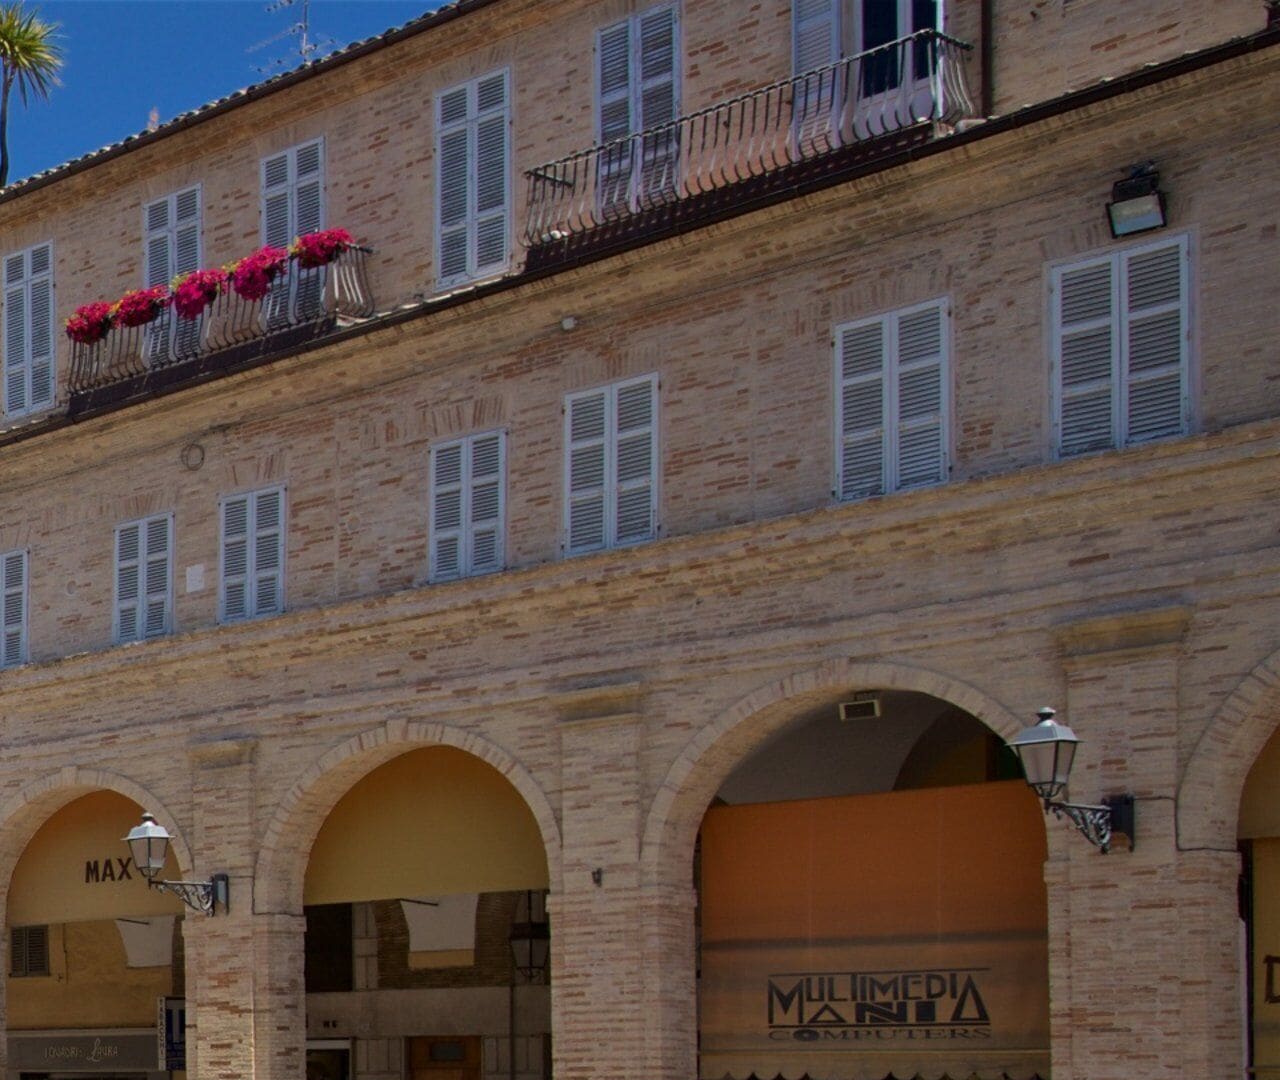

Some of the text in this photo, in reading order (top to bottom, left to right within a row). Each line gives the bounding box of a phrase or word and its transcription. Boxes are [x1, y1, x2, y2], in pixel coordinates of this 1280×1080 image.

[84, 857, 133, 883] MAX
[768, 973, 990, 1020] MULTIMEDIA
[768, 1027, 991, 1042] COMPUTERS
